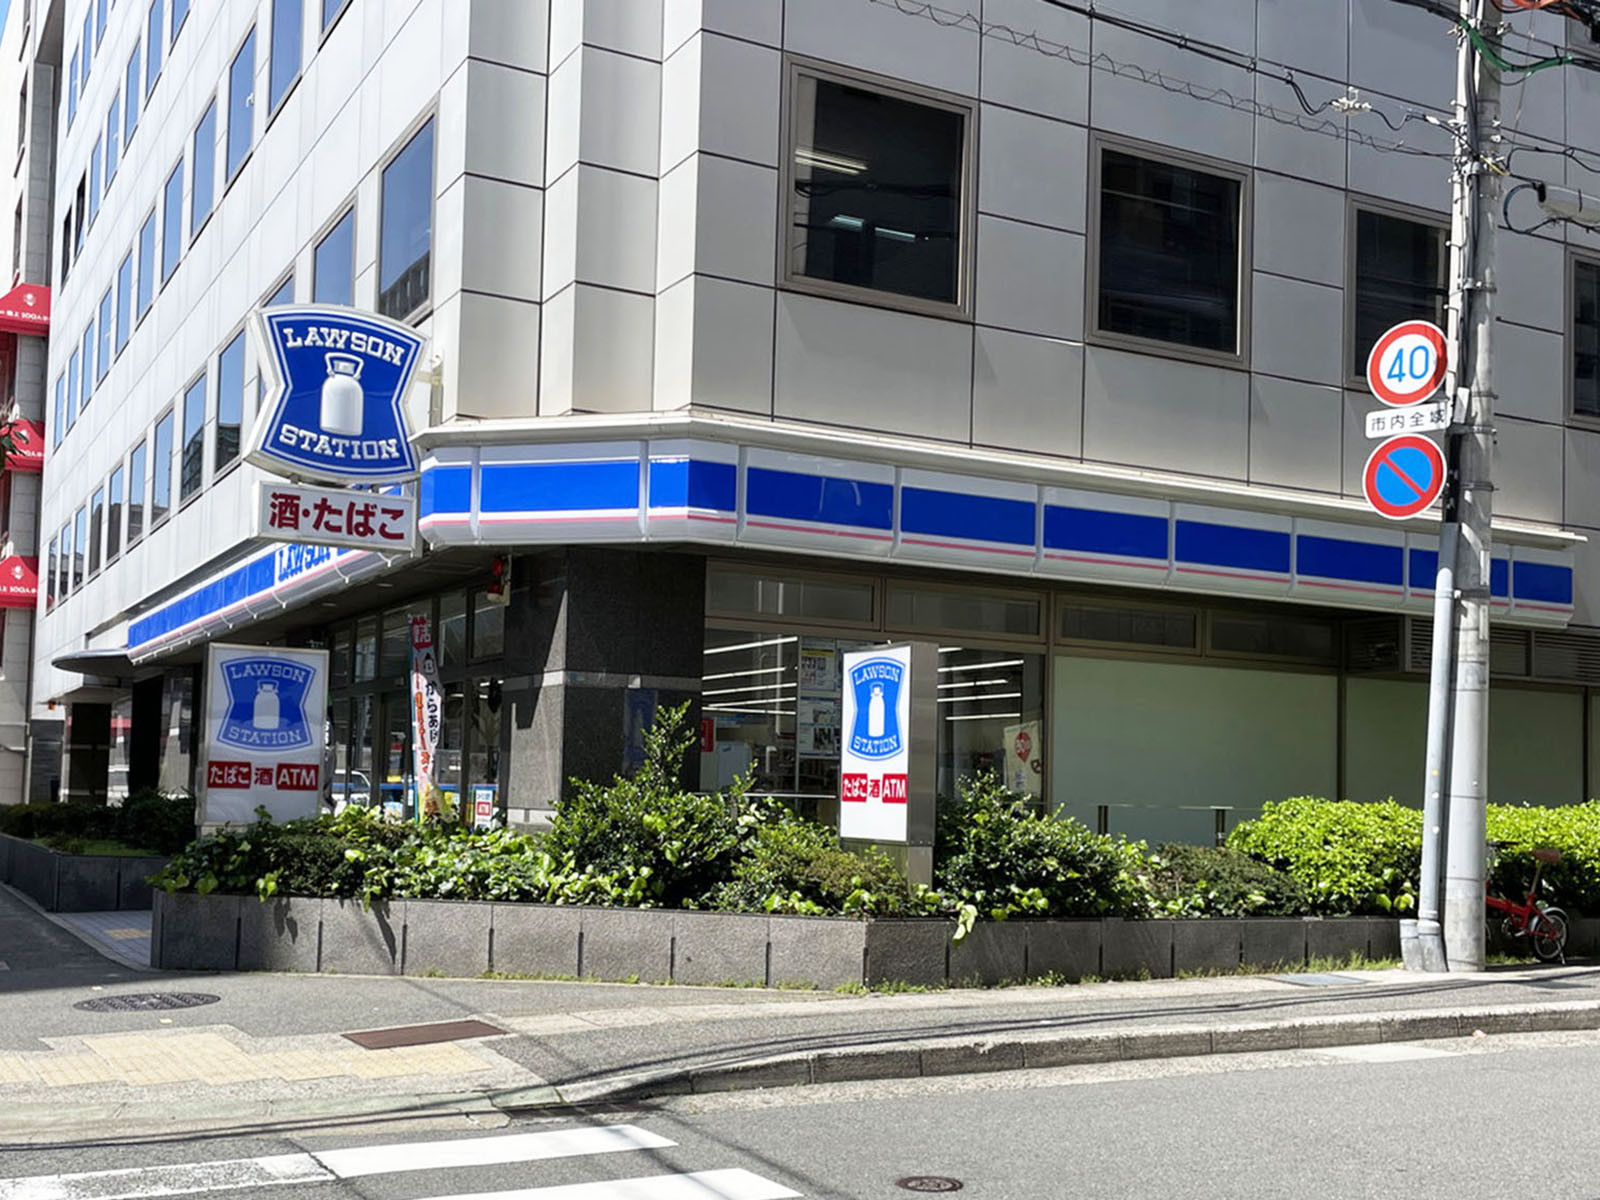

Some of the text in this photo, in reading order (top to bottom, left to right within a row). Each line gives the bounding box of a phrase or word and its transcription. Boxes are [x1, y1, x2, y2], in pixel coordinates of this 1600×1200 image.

[283, 327, 405, 366] LAWSON
[1387, 345, 1429, 382] 40
[279, 424, 400, 460] STATION
[269, 492, 405, 540] 酒・たばこ
[230, 664, 306, 683] LAWSON
[854, 665, 900, 685] LAWSON
[228, 726, 301, 744] STATION
[853, 735, 898, 754] STATION
[210, 764, 316, 786] たばこ 酒 ATM
[843, 778, 866, 798] たばこ
[883, 778, 906, 798] ATM
